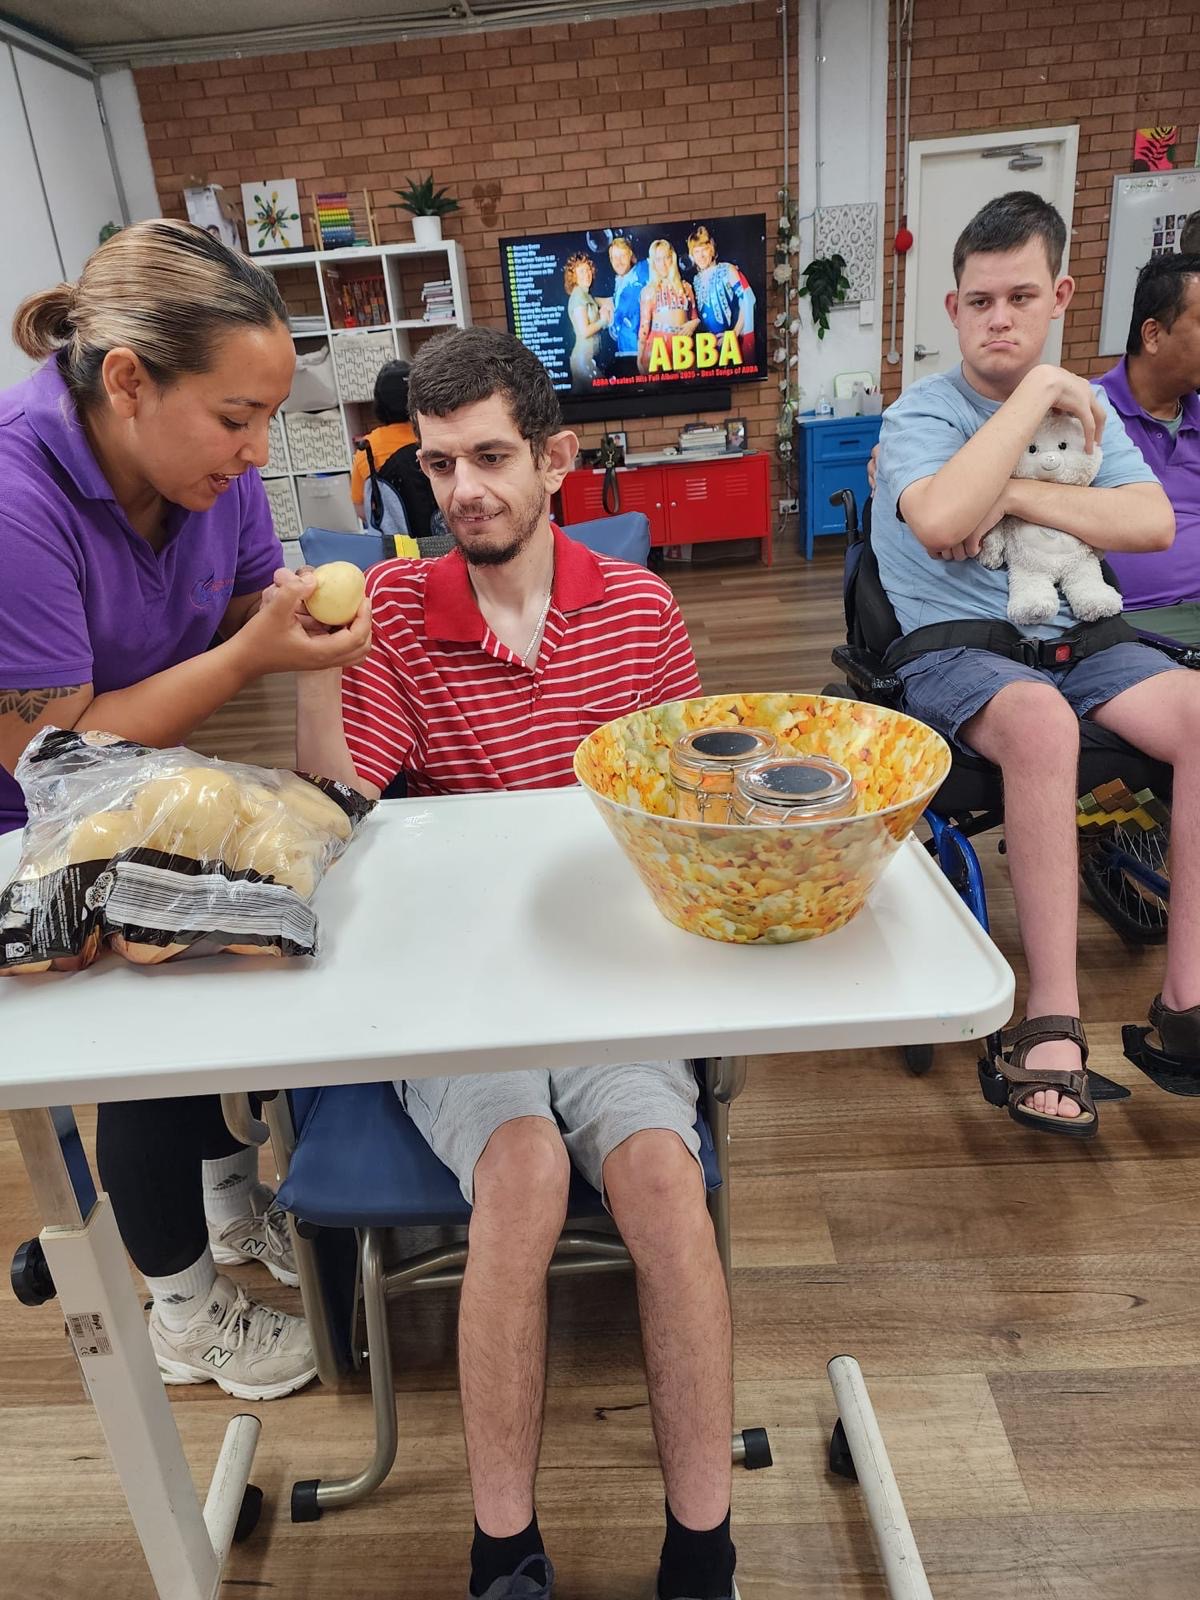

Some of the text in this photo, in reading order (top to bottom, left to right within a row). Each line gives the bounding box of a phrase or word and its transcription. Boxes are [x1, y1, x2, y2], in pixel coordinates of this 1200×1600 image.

[648, 330, 743, 373] ABBA
[648, 373, 660, 382] Full
[742, 365, 759, 374] ABBA
[241, 1238, 267, 1256] N
[202, 1345, 233, 1368] N
